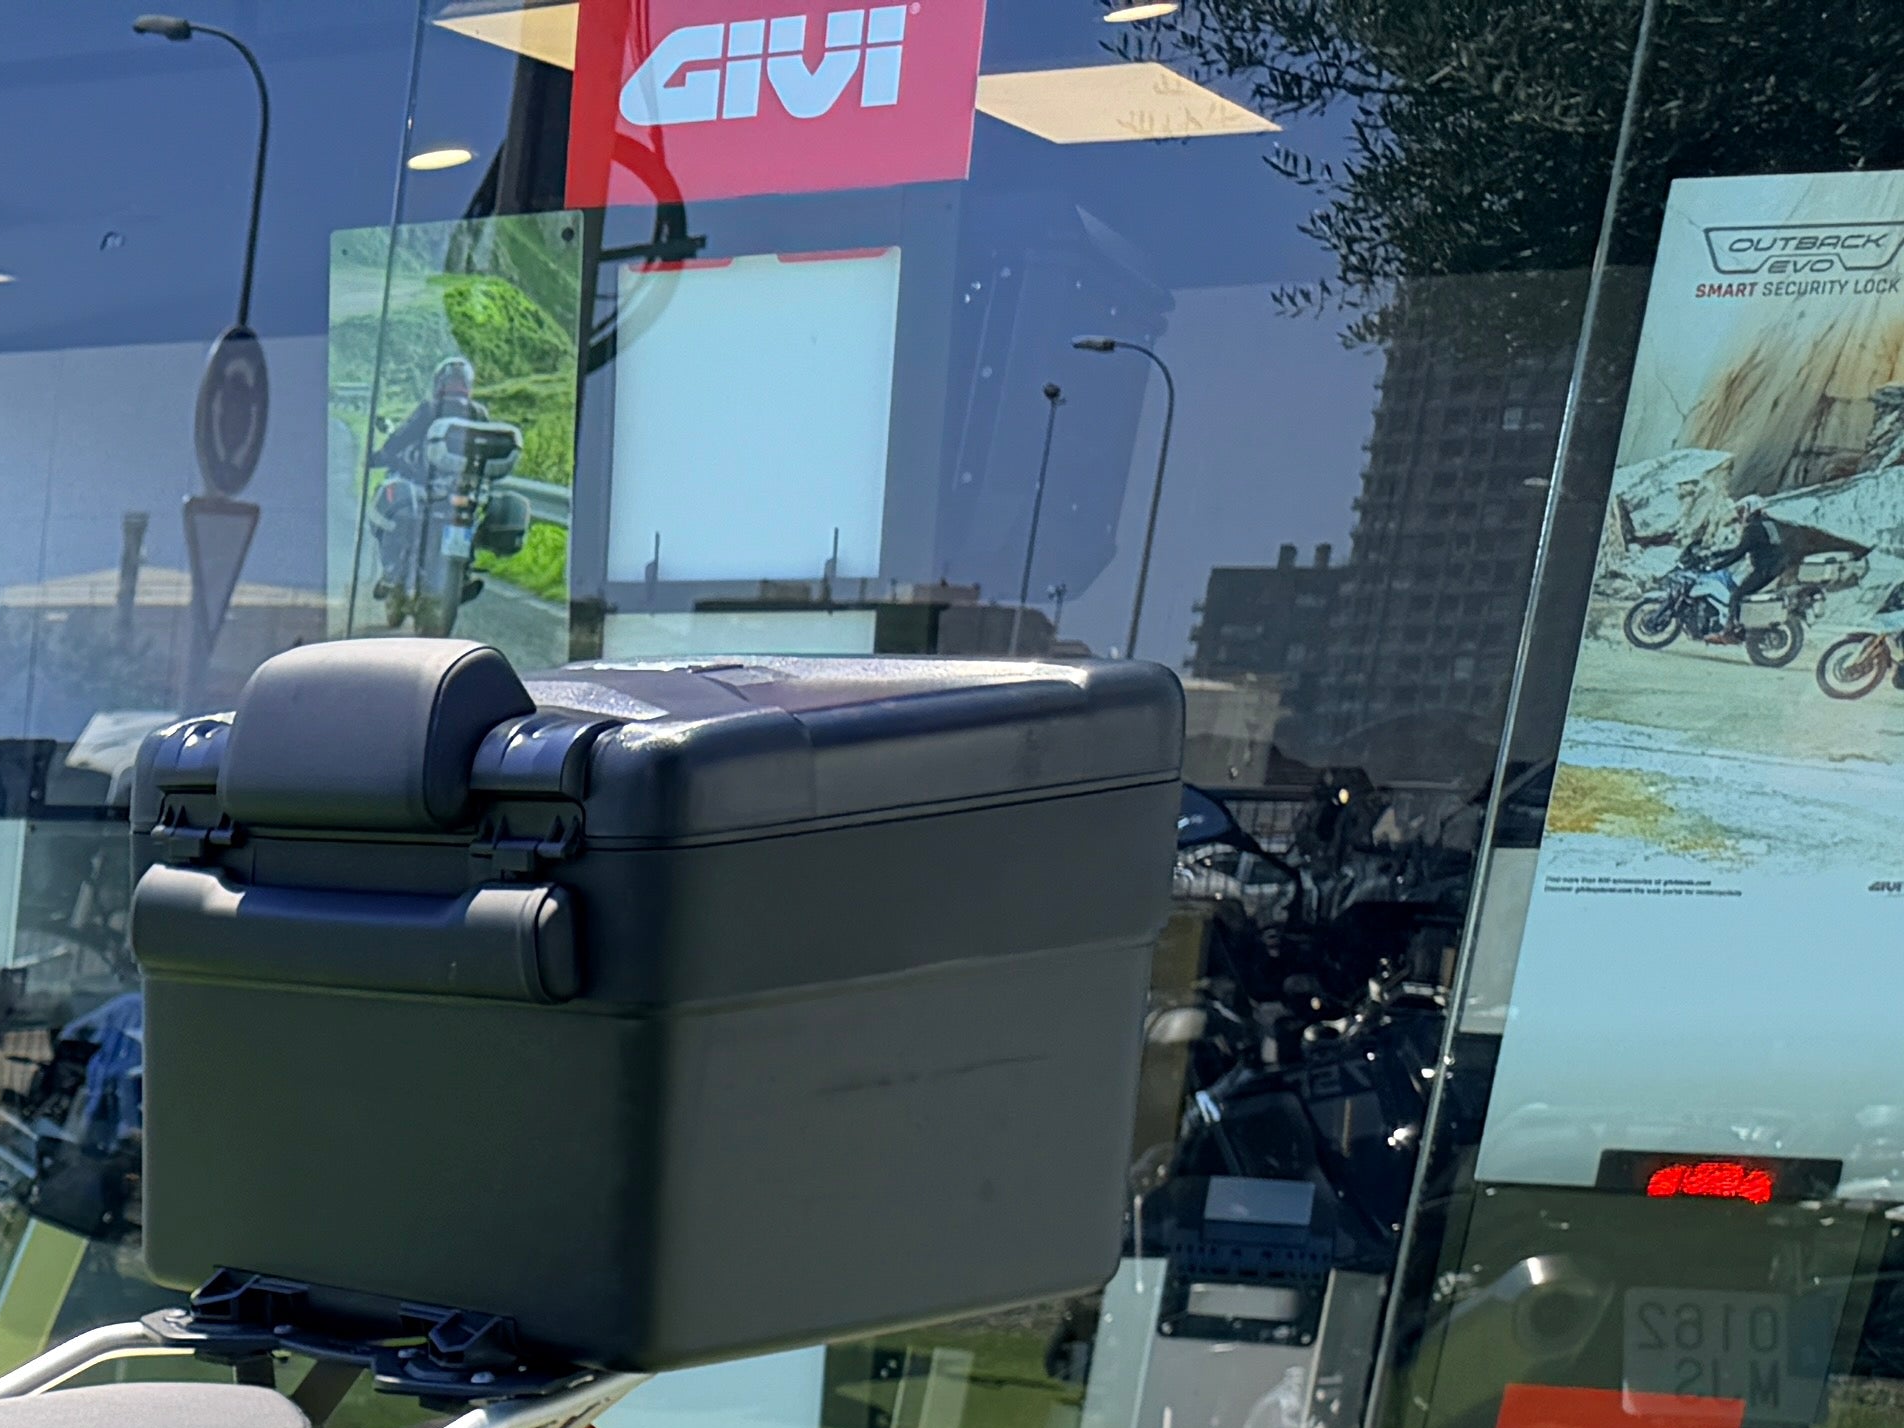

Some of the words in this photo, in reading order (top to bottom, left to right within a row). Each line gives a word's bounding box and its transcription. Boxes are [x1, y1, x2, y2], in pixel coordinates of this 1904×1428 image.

[619, 6, 907, 127] GIVI
[1728, 233, 1889, 252] OUTBACK
[1767, 258, 1834, 274] EVO
[1695, 282, 1758, 298] SMART
[1762, 280, 1849, 297] SECURITY
[1854, 278, 1901, 295] LOCK
